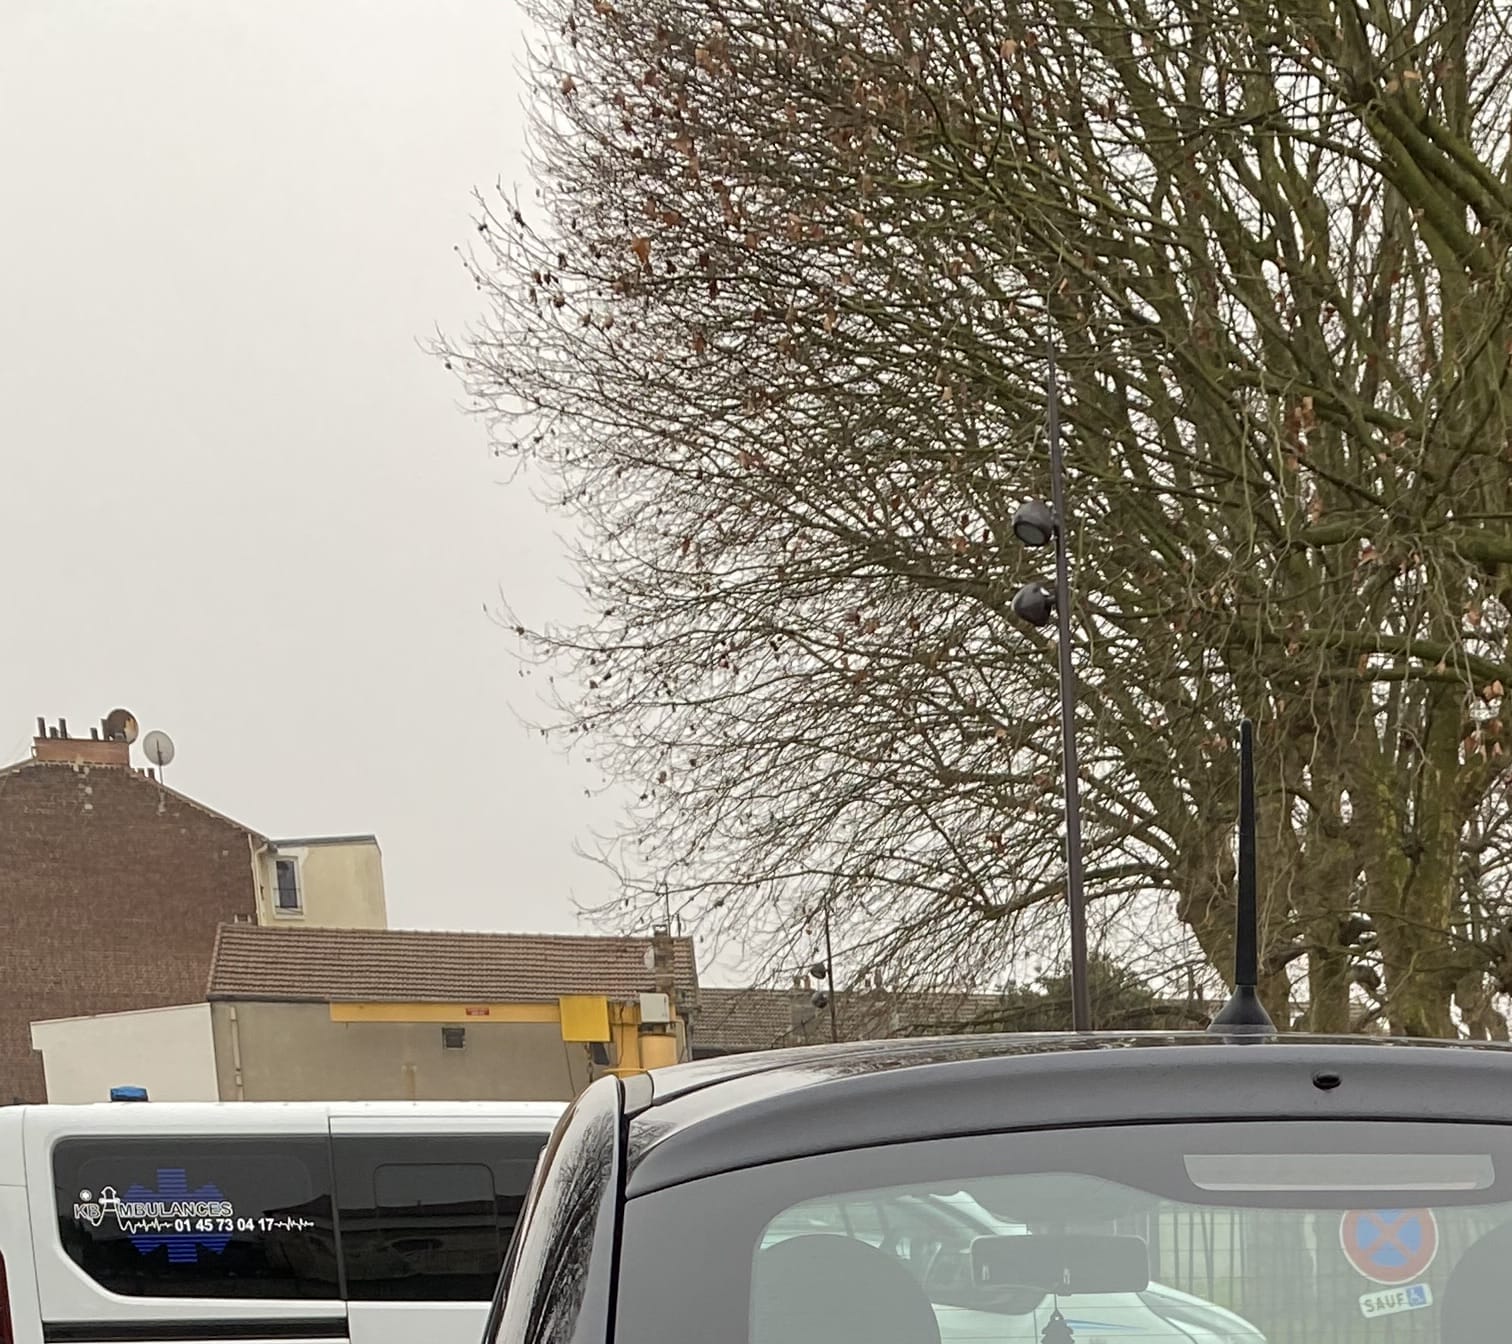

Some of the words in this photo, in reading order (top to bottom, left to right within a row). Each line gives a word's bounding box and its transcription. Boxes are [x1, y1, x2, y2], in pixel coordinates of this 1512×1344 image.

[174, 1218, 191, 1231] 01
[195, 1218, 213, 1231] 45
[216, 1218, 234, 1231] 73
[236, 1218, 255, 1231] 04
[258, 1218, 274, 1231] 17
[1363, 1293, 1406, 1312] SAUF
